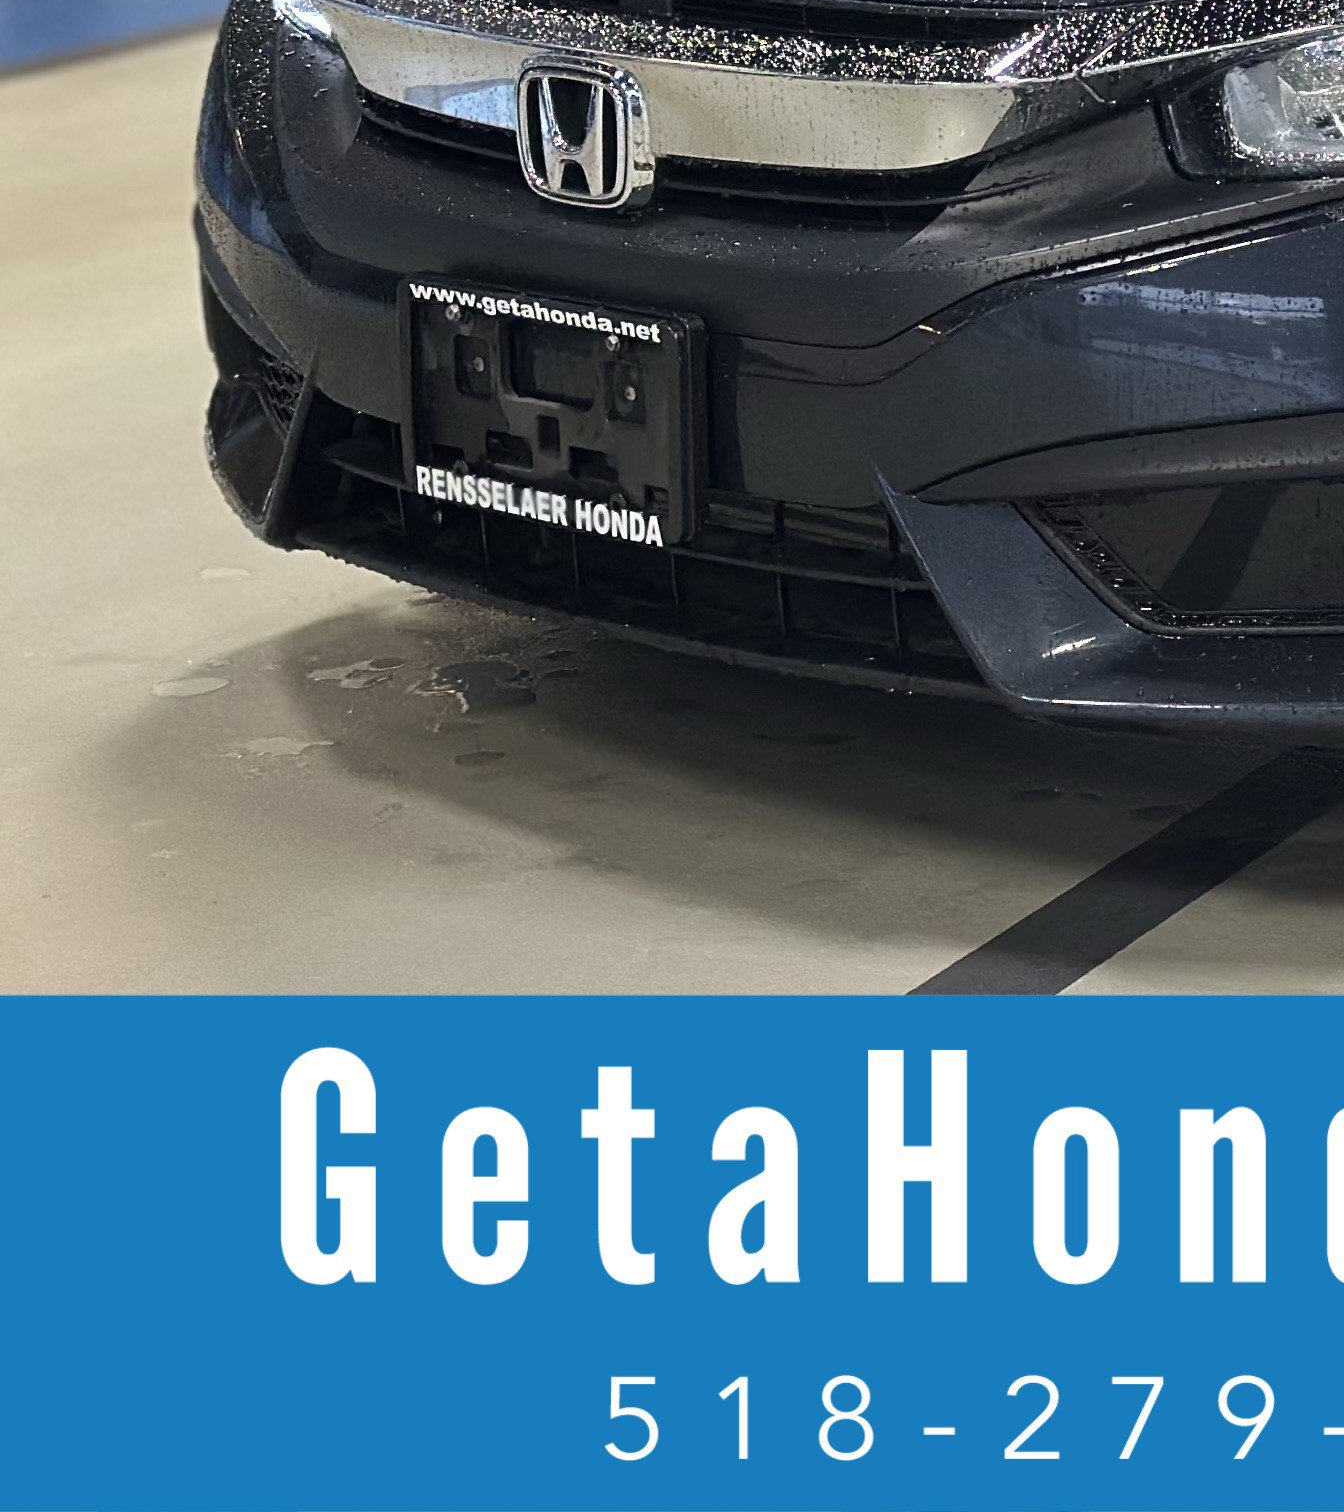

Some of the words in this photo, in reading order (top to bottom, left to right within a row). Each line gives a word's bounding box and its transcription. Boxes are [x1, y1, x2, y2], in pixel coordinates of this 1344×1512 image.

[409, 283, 662, 344] www.getahonda.net
[415, 464, 568, 527] RENSSELAER
[574, 498, 664, 548] HONDA
